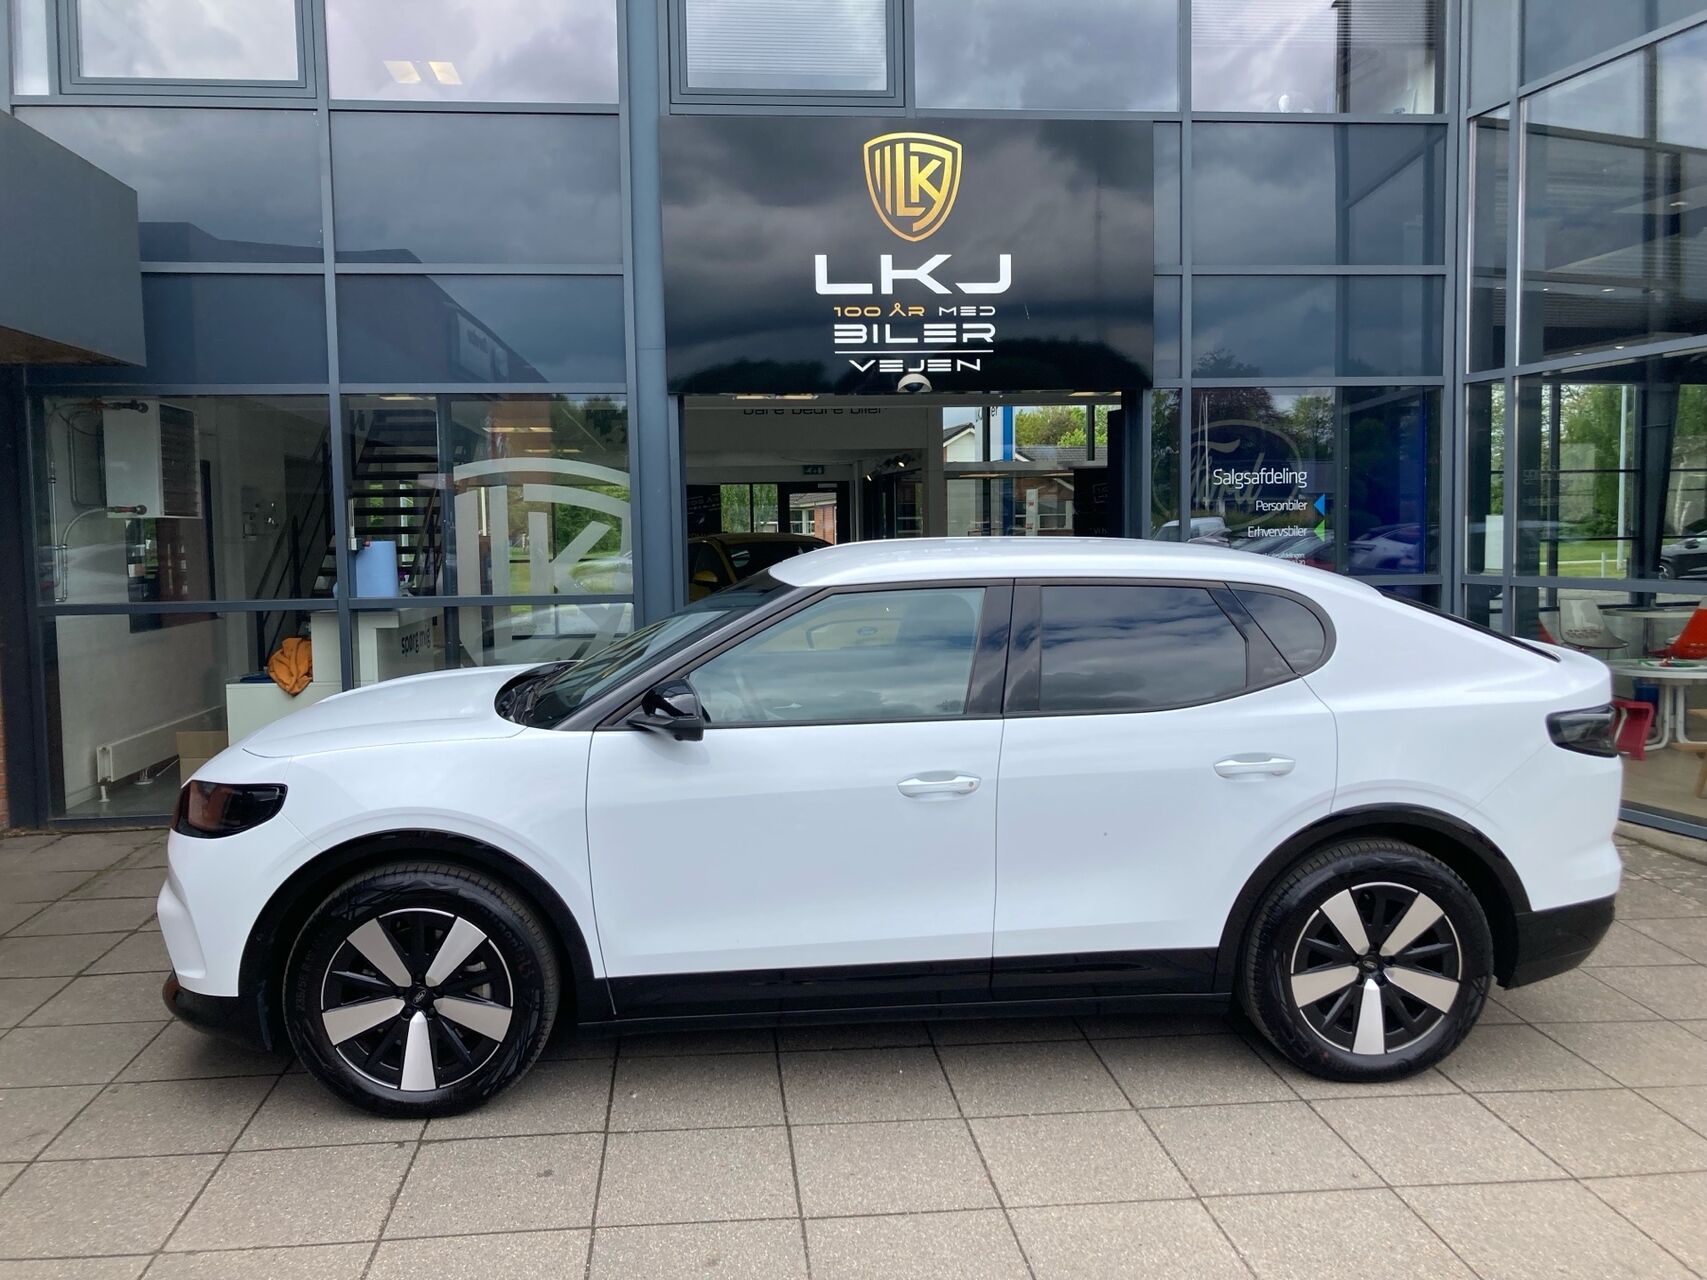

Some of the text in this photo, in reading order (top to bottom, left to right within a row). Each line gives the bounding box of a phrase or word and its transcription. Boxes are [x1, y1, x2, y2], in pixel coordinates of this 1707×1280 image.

[814, 254, 1012, 295] LKJ
[834, 302, 996, 317] 100 ÅR MED
[833, 323, 996, 344] BILER
[849, 358, 981, 373] VEJEN
[1212, 467, 1308, 489] Salgsafdeling
[1255, 500, 1308, 512] Personbiler
[1247, 525, 1308, 538] Erhvervsbiler
